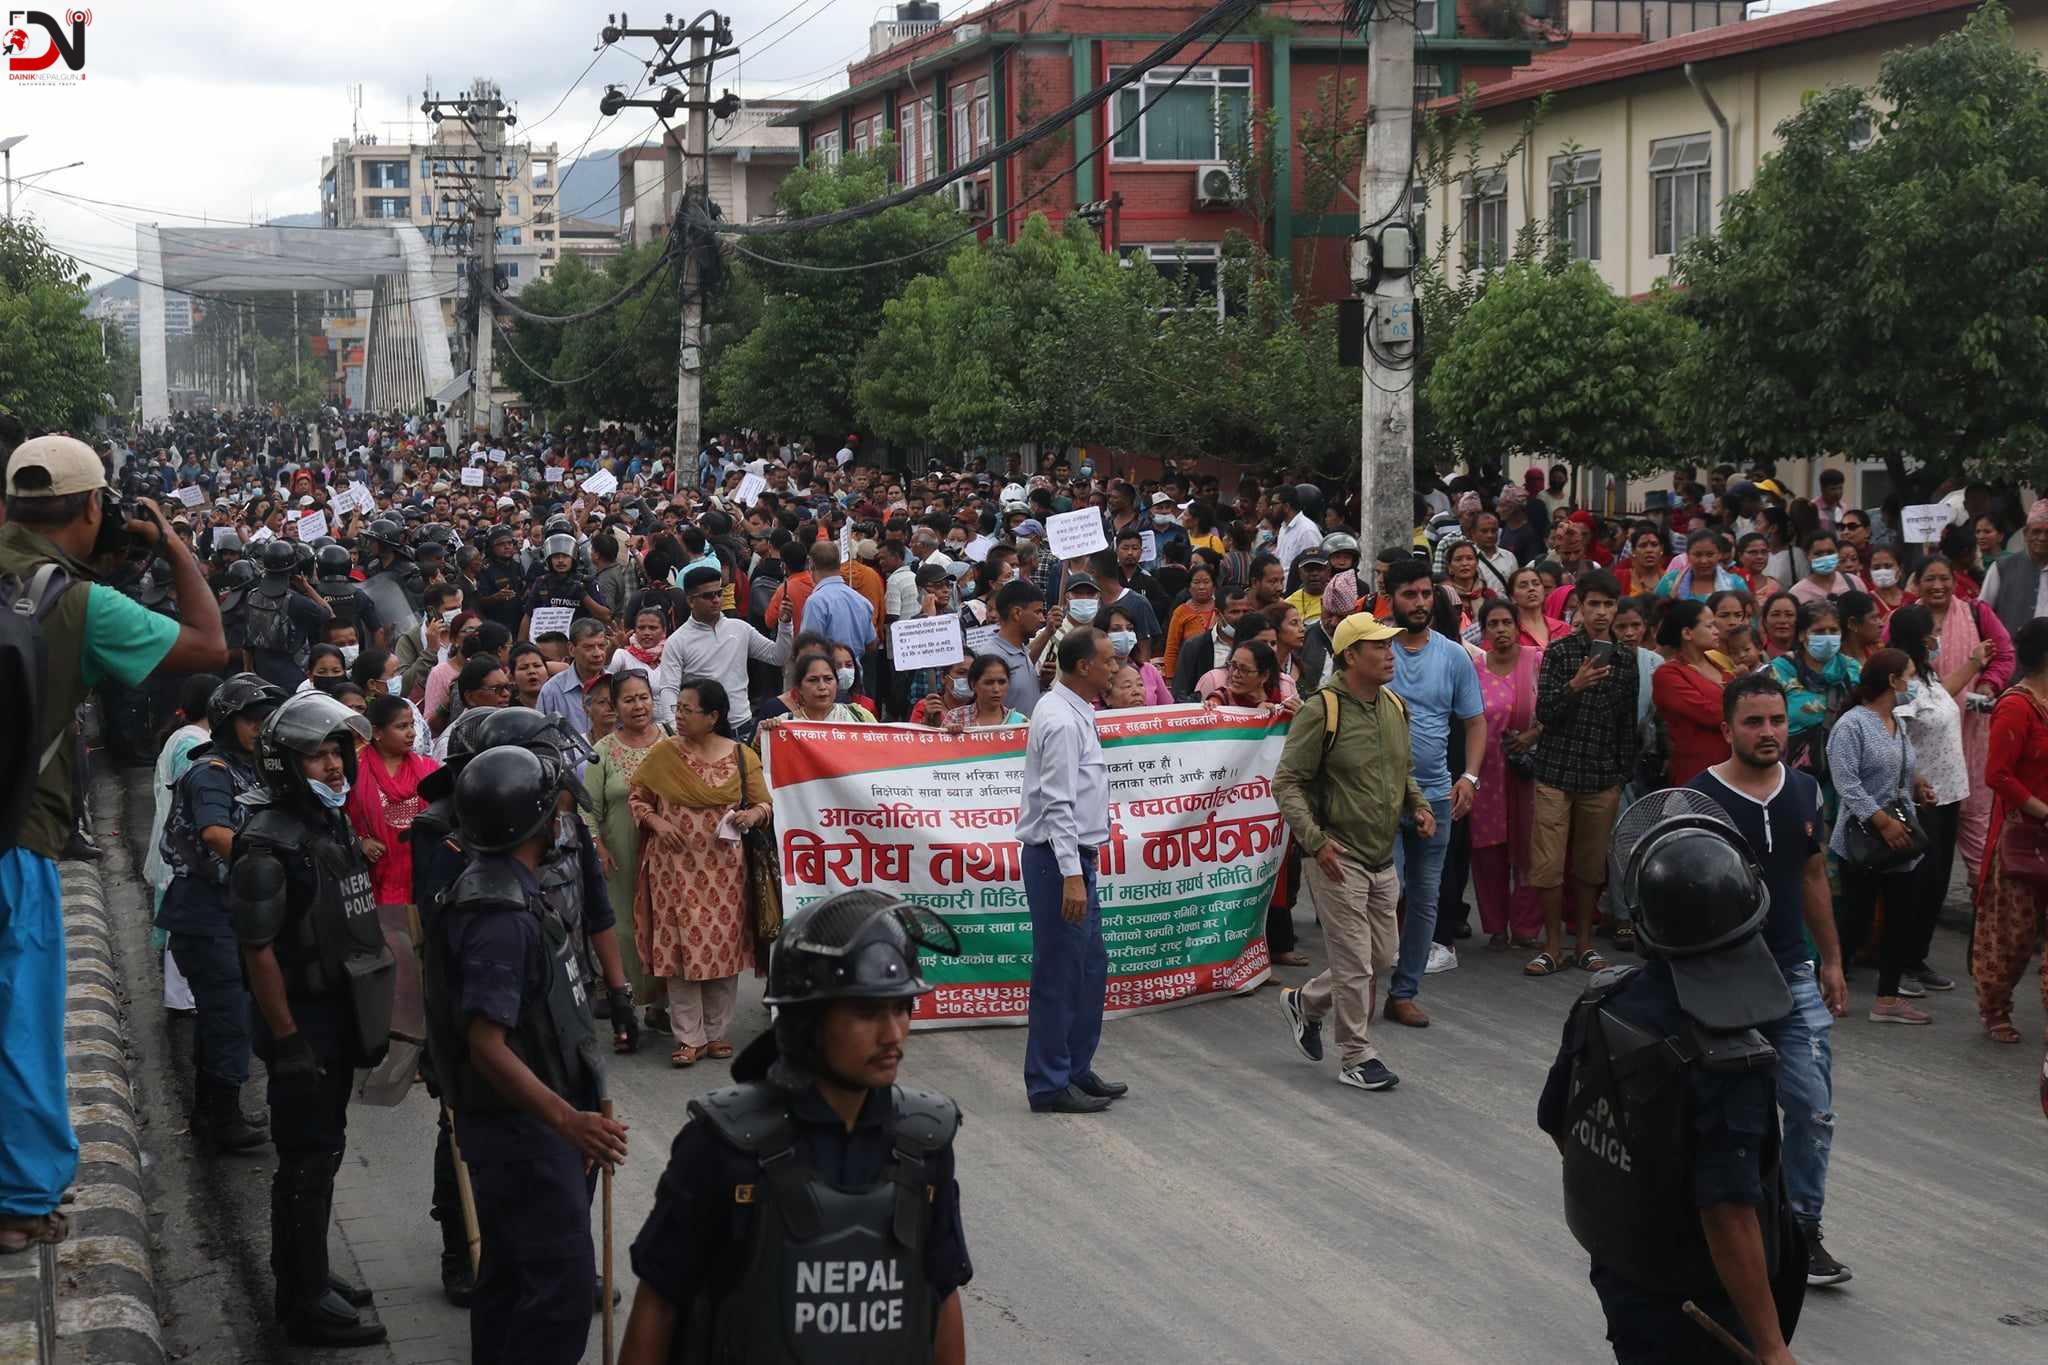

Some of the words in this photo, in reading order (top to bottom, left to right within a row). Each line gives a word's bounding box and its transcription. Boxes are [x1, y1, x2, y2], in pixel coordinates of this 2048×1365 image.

[779, 729, 787, 742] ए
[792, 729, 828, 741] सरकार
[832, 728, 846, 741] कि
[849, 731, 858, 741] त
[1126, 718, 1163, 733] सहकारी
[932, 769, 960, 783] नेपाल
[966, 768, 999, 782] भरिका
[1138, 760, 1156, 773] एक
[1149, 773, 1174, 788] लागी
[818, 804, 943, 829] आन्दोलित
[949, 807, 1021, 830] सहका
[783, 829, 914, 887] बिरोध
[928, 841, 1023, 886] तथा
[1140, 811, 1286, 872] कार्यक्रम
[340, 871, 372, 897] NEPA
[1207, 865, 1253, 889] समिति
[344, 892, 377, 919] POLIC
[989, 922, 1015, 935] सावा
[1208, 899, 1241, 913] परिवार
[1105, 971, 1196, 993] ०२३४१५०५
[935, 1000, 1030, 1014] ९७६६८९०
[796, 1259, 904, 1294] NEPAL
[794, 1298, 904, 1334] POLICE
